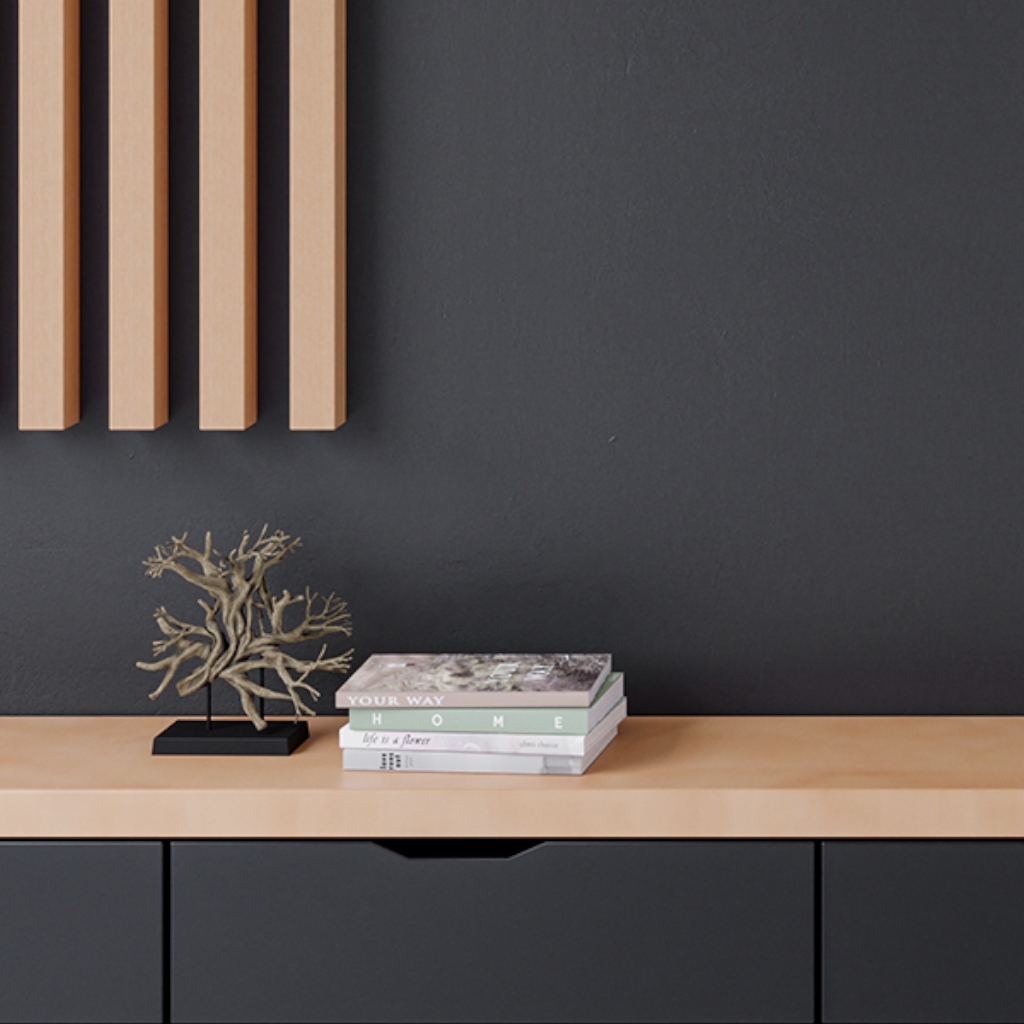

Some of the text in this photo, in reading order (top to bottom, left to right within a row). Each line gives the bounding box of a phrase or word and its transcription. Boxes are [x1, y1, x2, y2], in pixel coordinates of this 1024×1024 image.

[347, 696, 445, 706] YOUR WAY
[371, 713, 564, 730] HOME
[400, 733, 432, 748] flower
